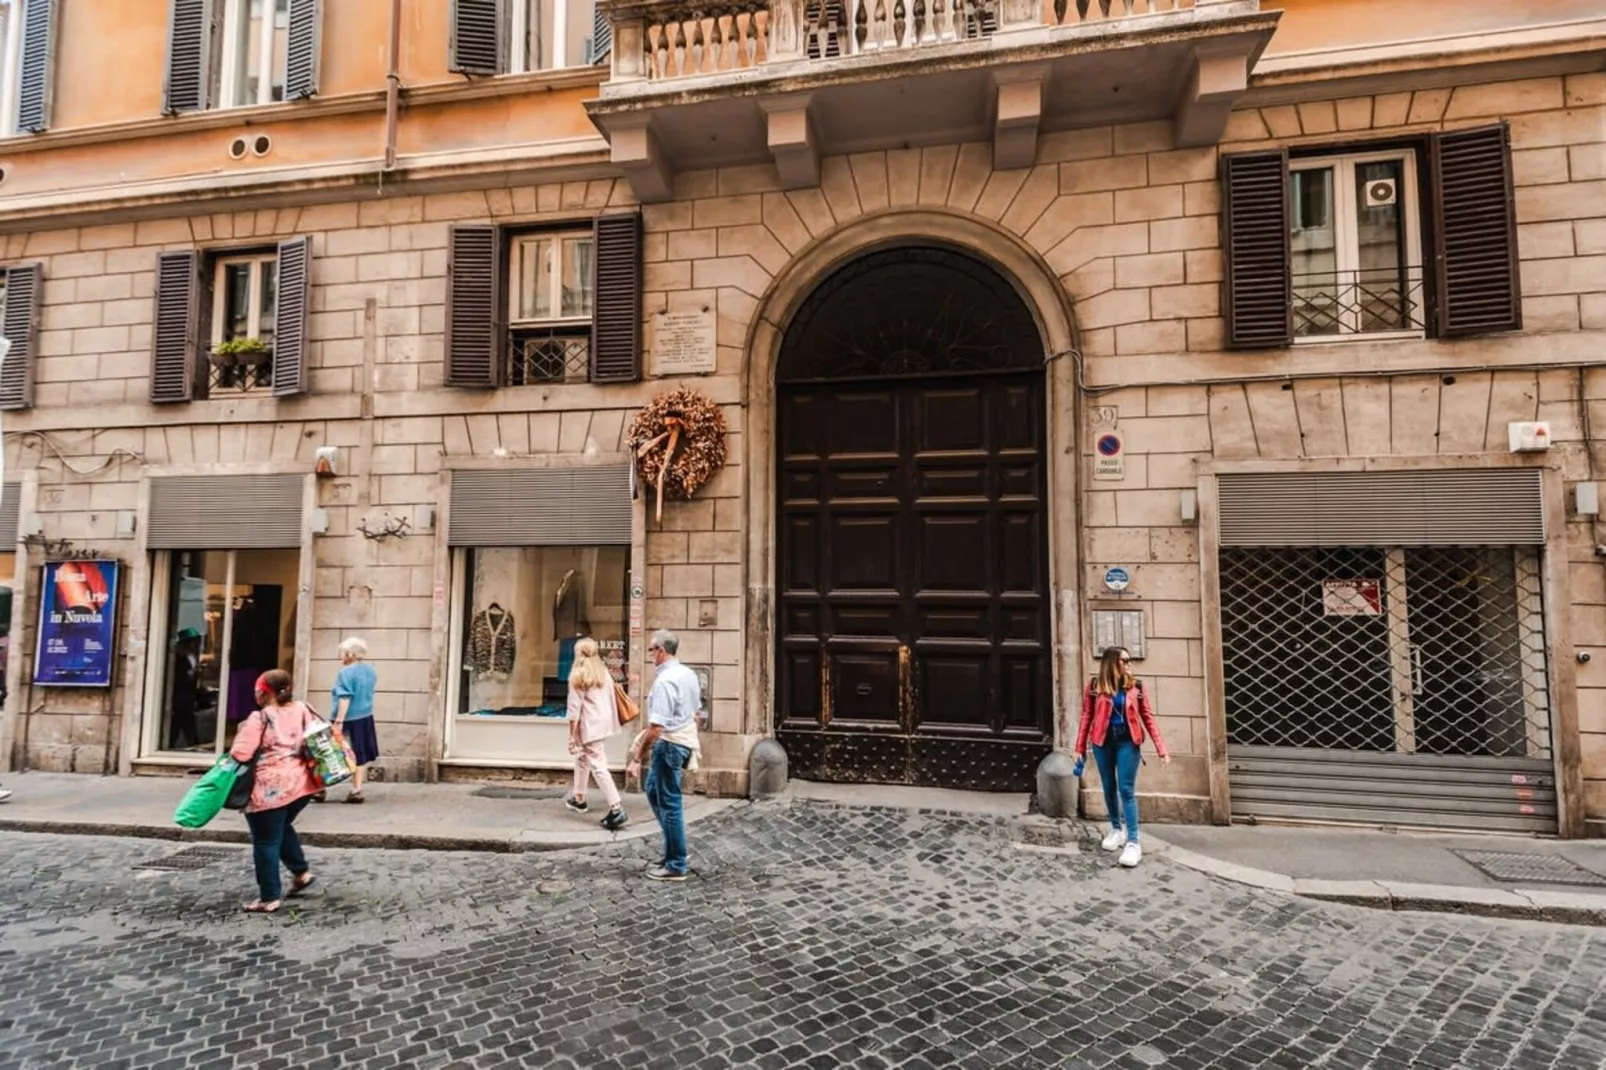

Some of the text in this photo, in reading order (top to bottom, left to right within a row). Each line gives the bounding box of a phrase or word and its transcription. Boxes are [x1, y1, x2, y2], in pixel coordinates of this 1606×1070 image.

[1091, 408, 1114, 425] 39
[84, 590, 109, 602] Arte
[50, 610, 103, 624] in Nuvola
[595, 640, 626, 649] ARKET
